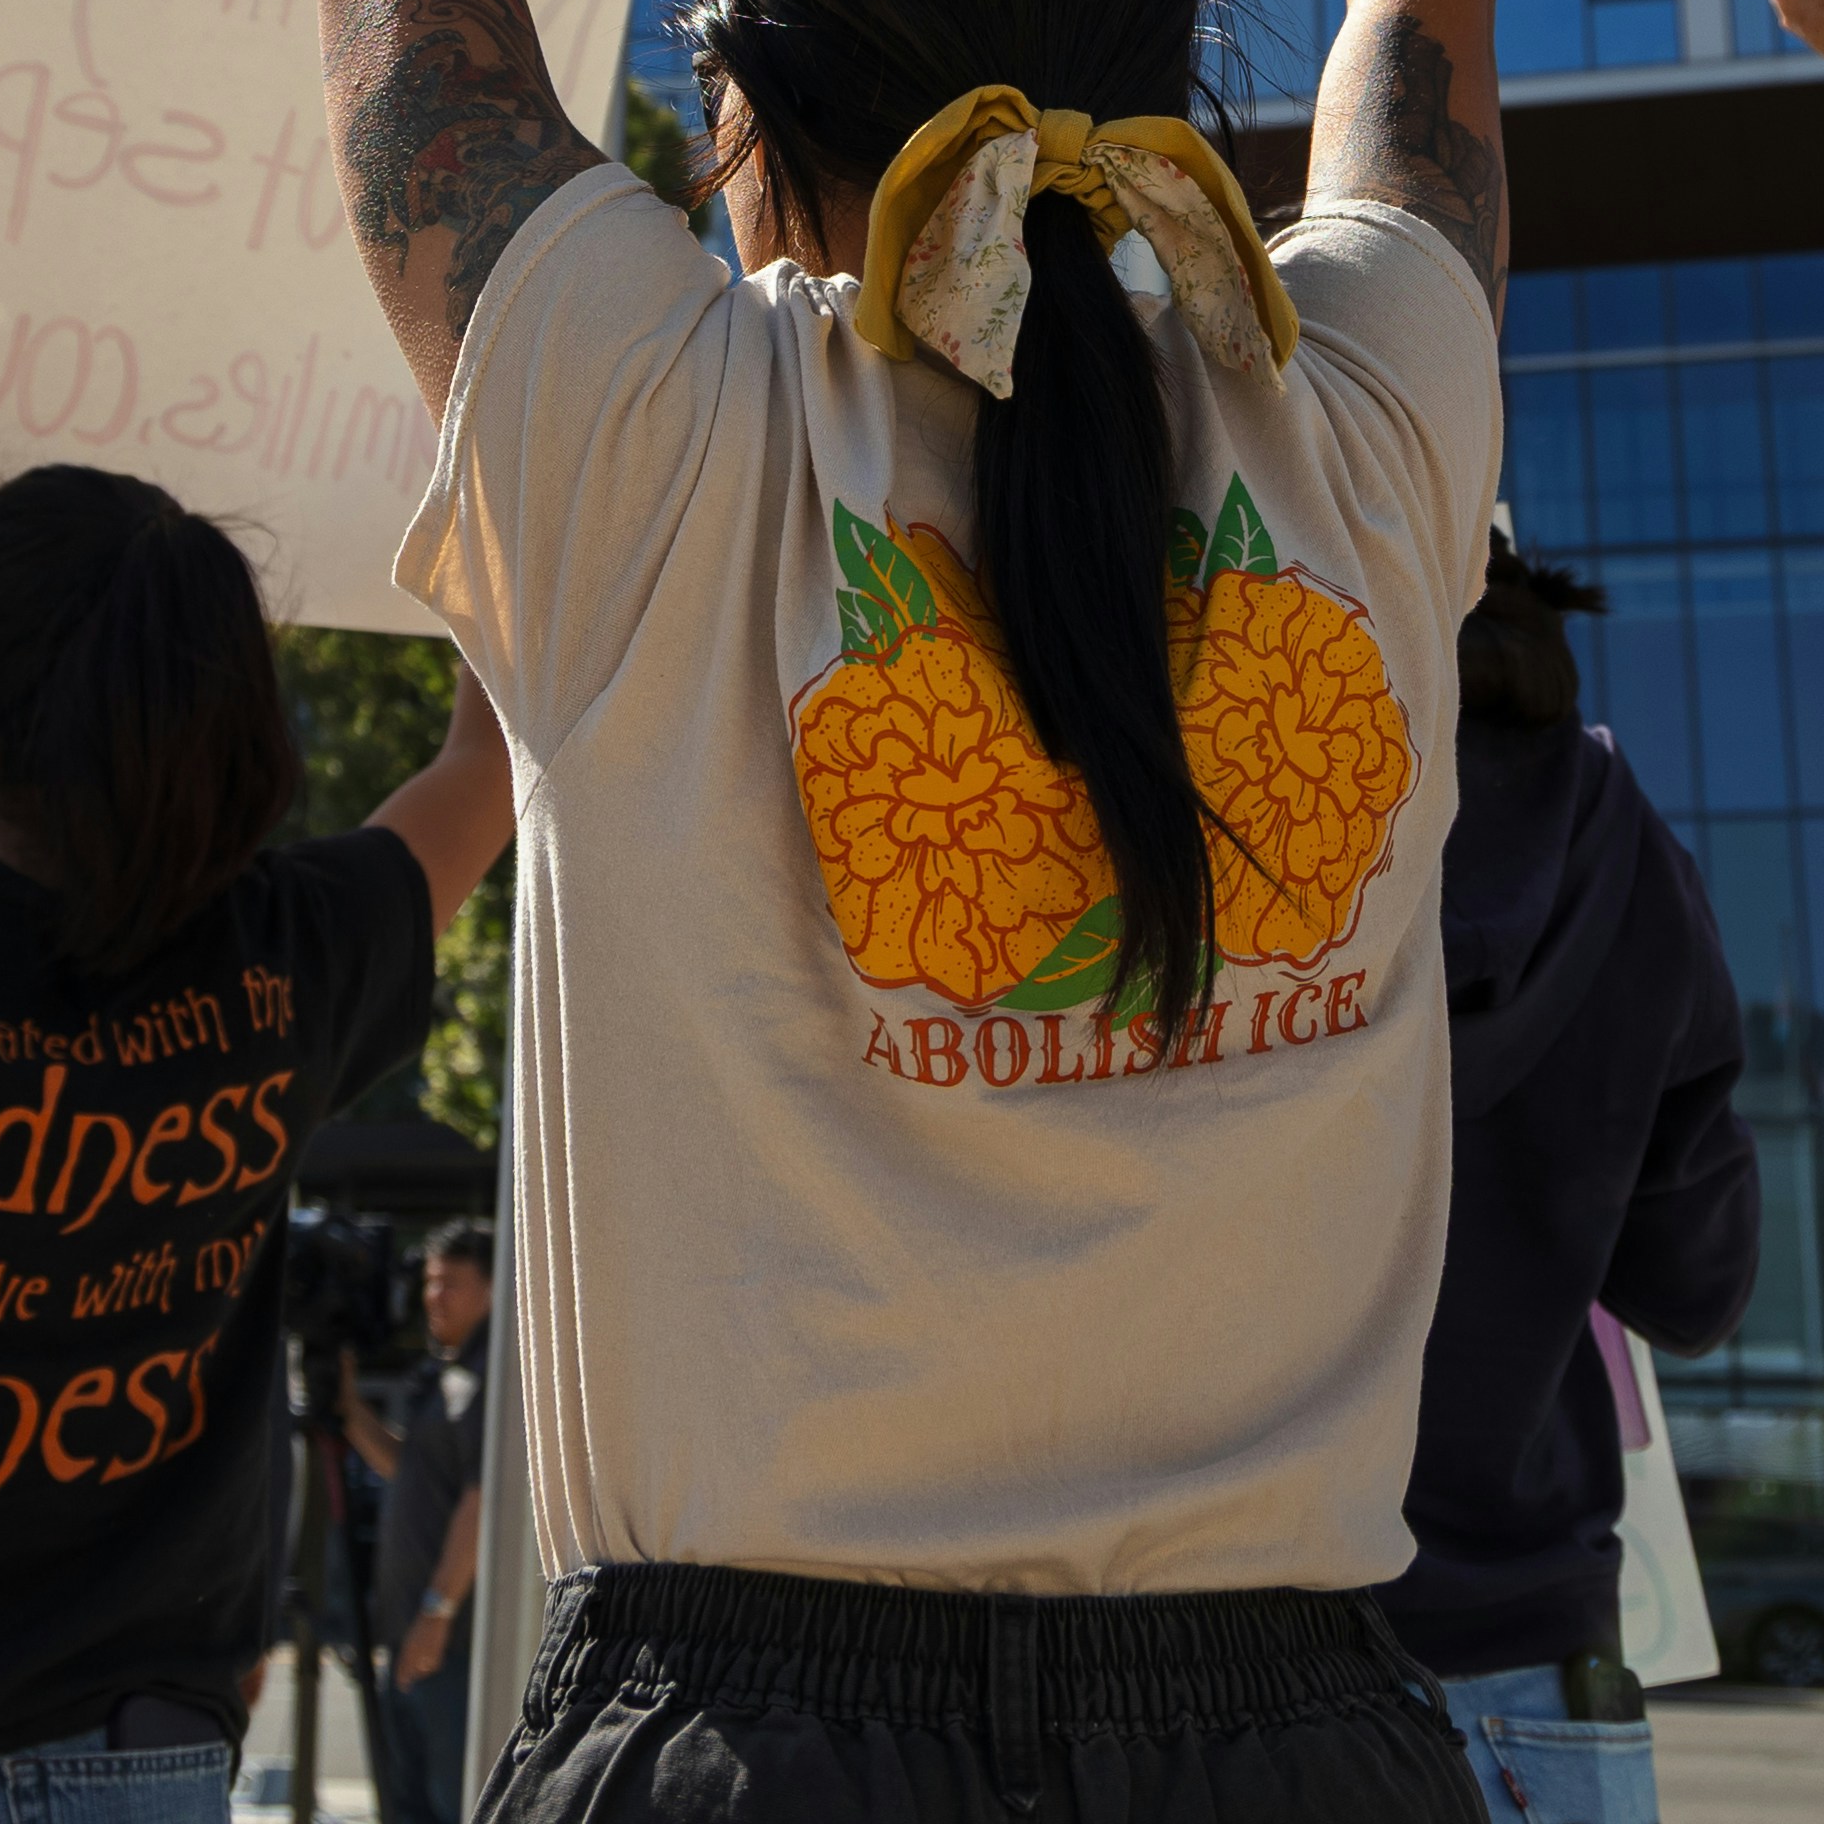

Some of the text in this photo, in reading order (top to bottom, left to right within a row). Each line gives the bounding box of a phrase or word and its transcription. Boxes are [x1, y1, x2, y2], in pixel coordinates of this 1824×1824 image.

[112, 987, 229, 1066] with
[861, 968, 1370, 1088] ABOLISH ICE
[71, 1241, 179, 1321] with
